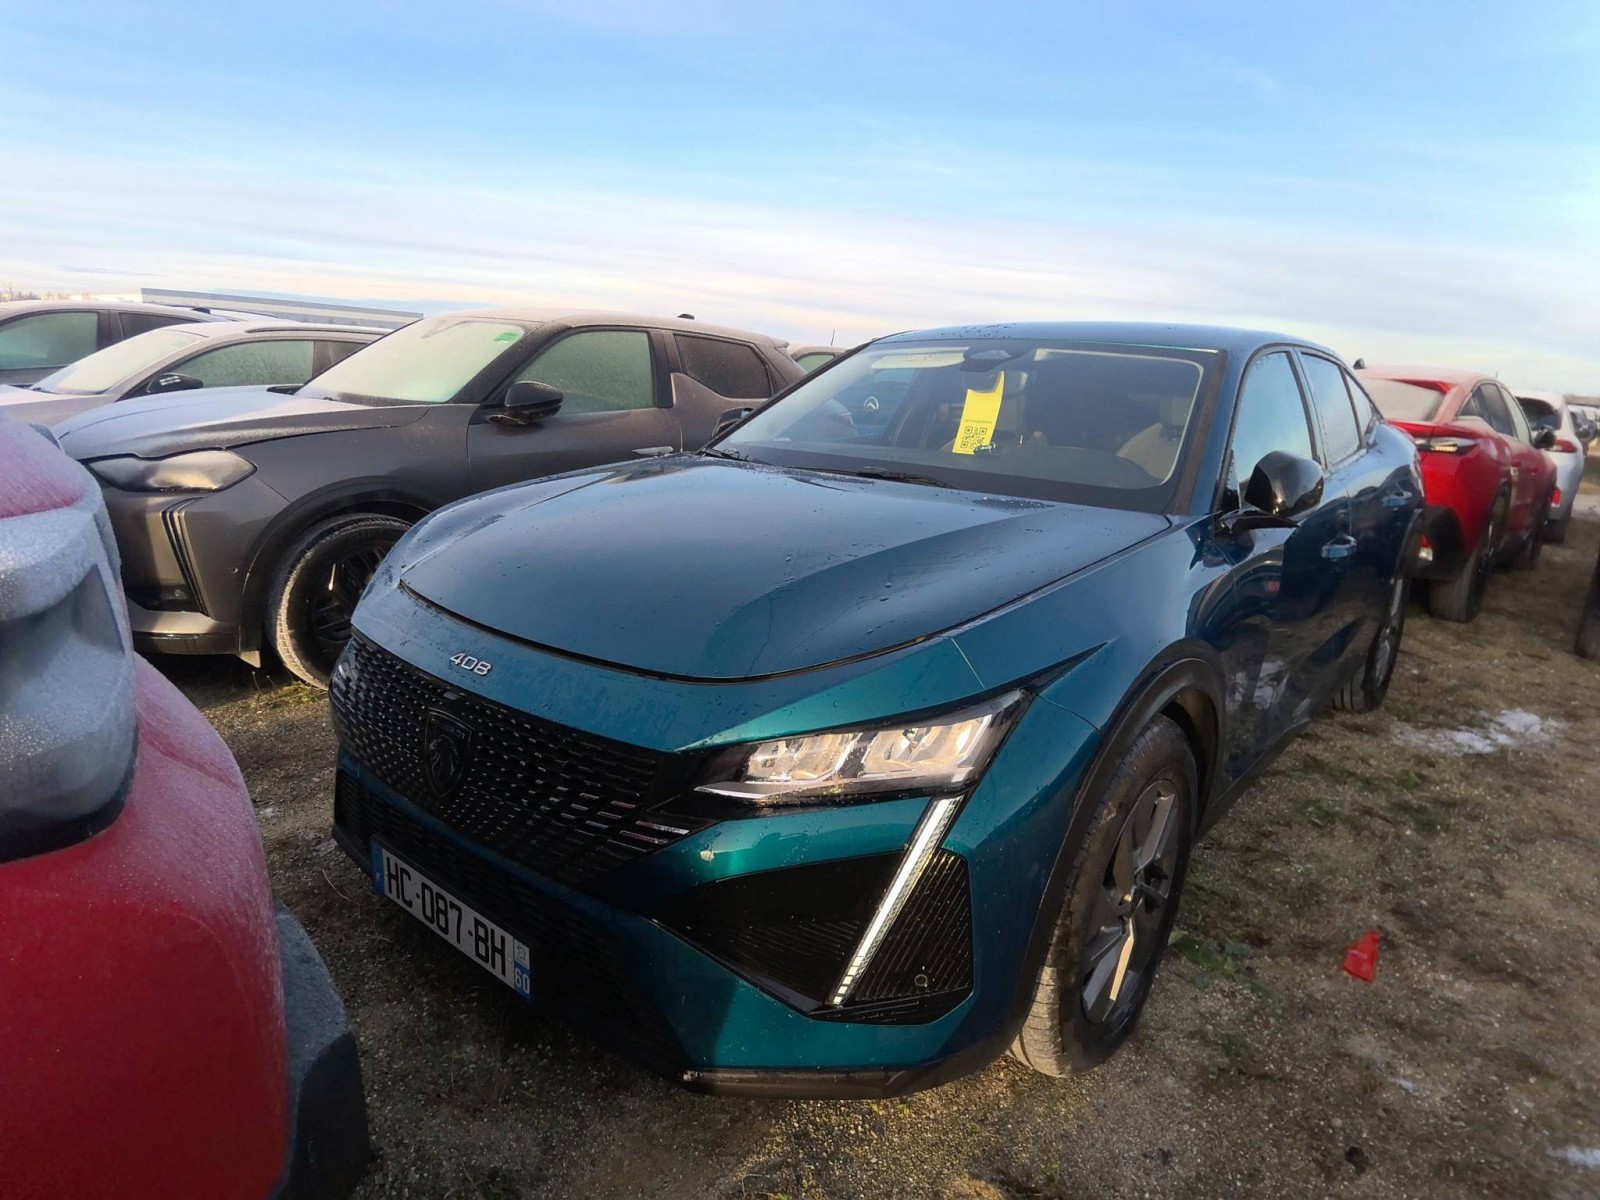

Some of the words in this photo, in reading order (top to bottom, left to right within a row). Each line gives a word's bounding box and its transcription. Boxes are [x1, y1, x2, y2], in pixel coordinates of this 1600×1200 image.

[450, 652, 491, 675] 408
[386, 856, 506, 977] HC-087-BH
[515, 967, 530, 995] 60
